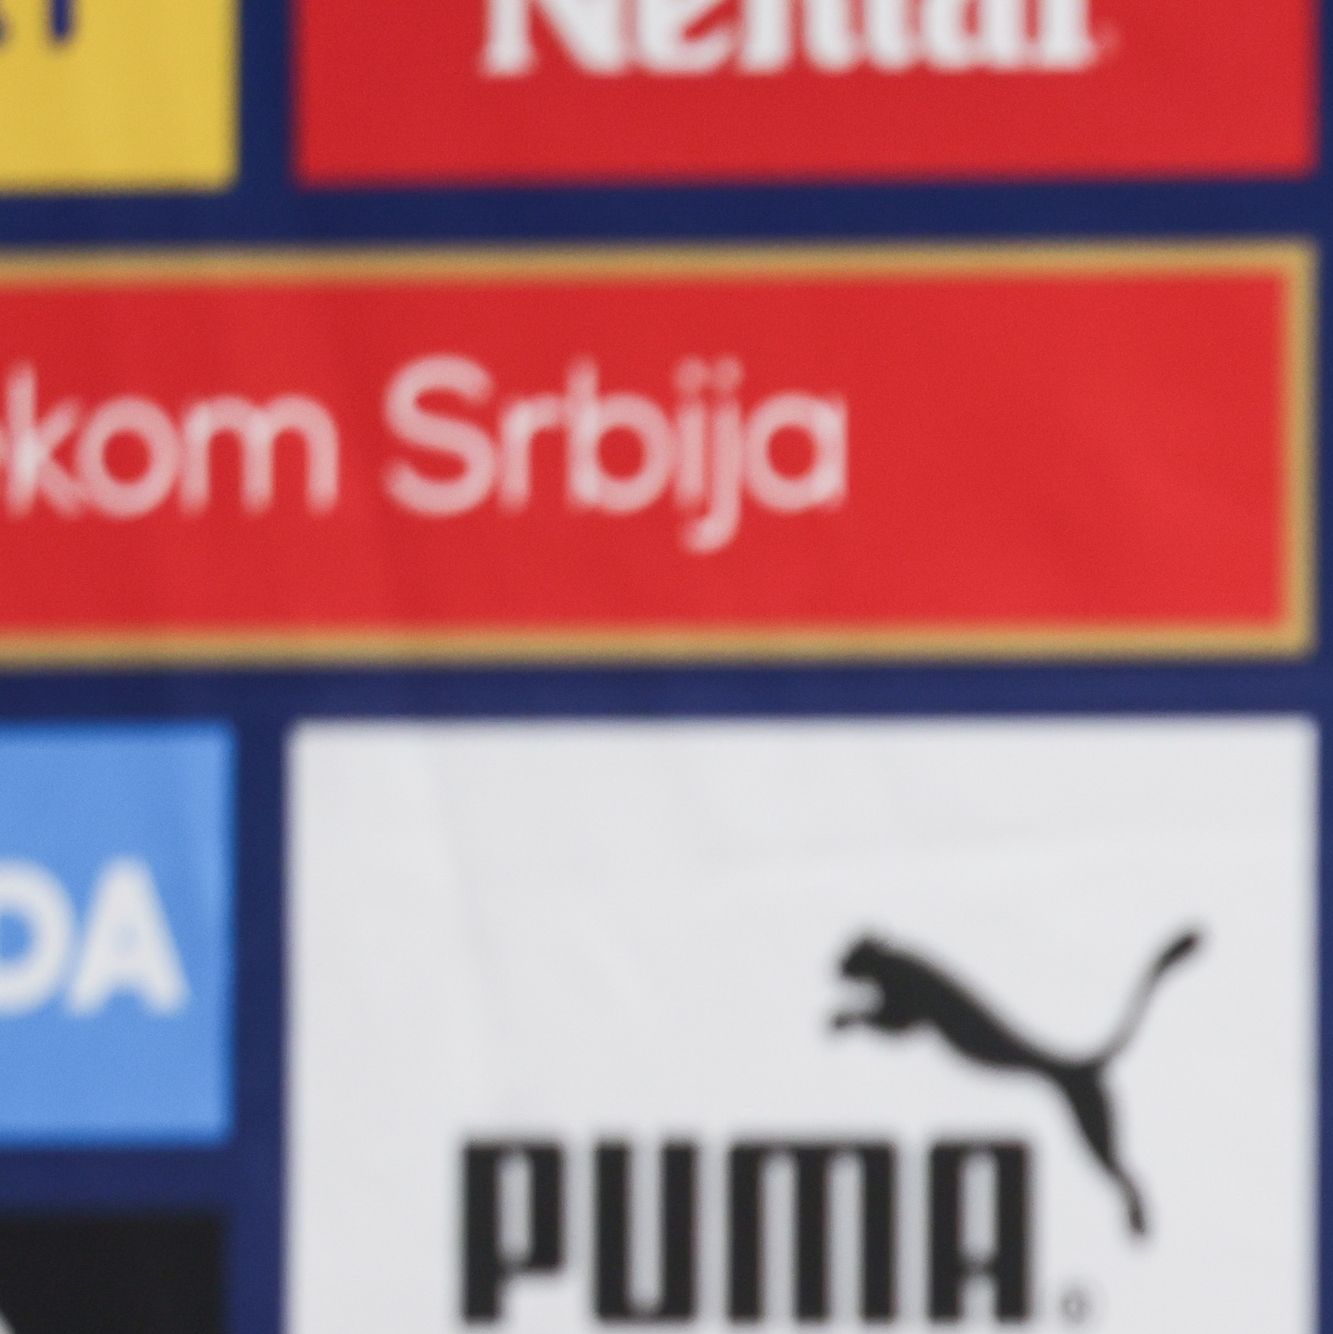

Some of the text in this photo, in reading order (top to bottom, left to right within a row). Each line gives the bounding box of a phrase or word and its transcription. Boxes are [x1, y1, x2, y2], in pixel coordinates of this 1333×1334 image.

[0, 352, 848, 556] kom Srbija
[457, 1137, 1035, 1326] PUMA
